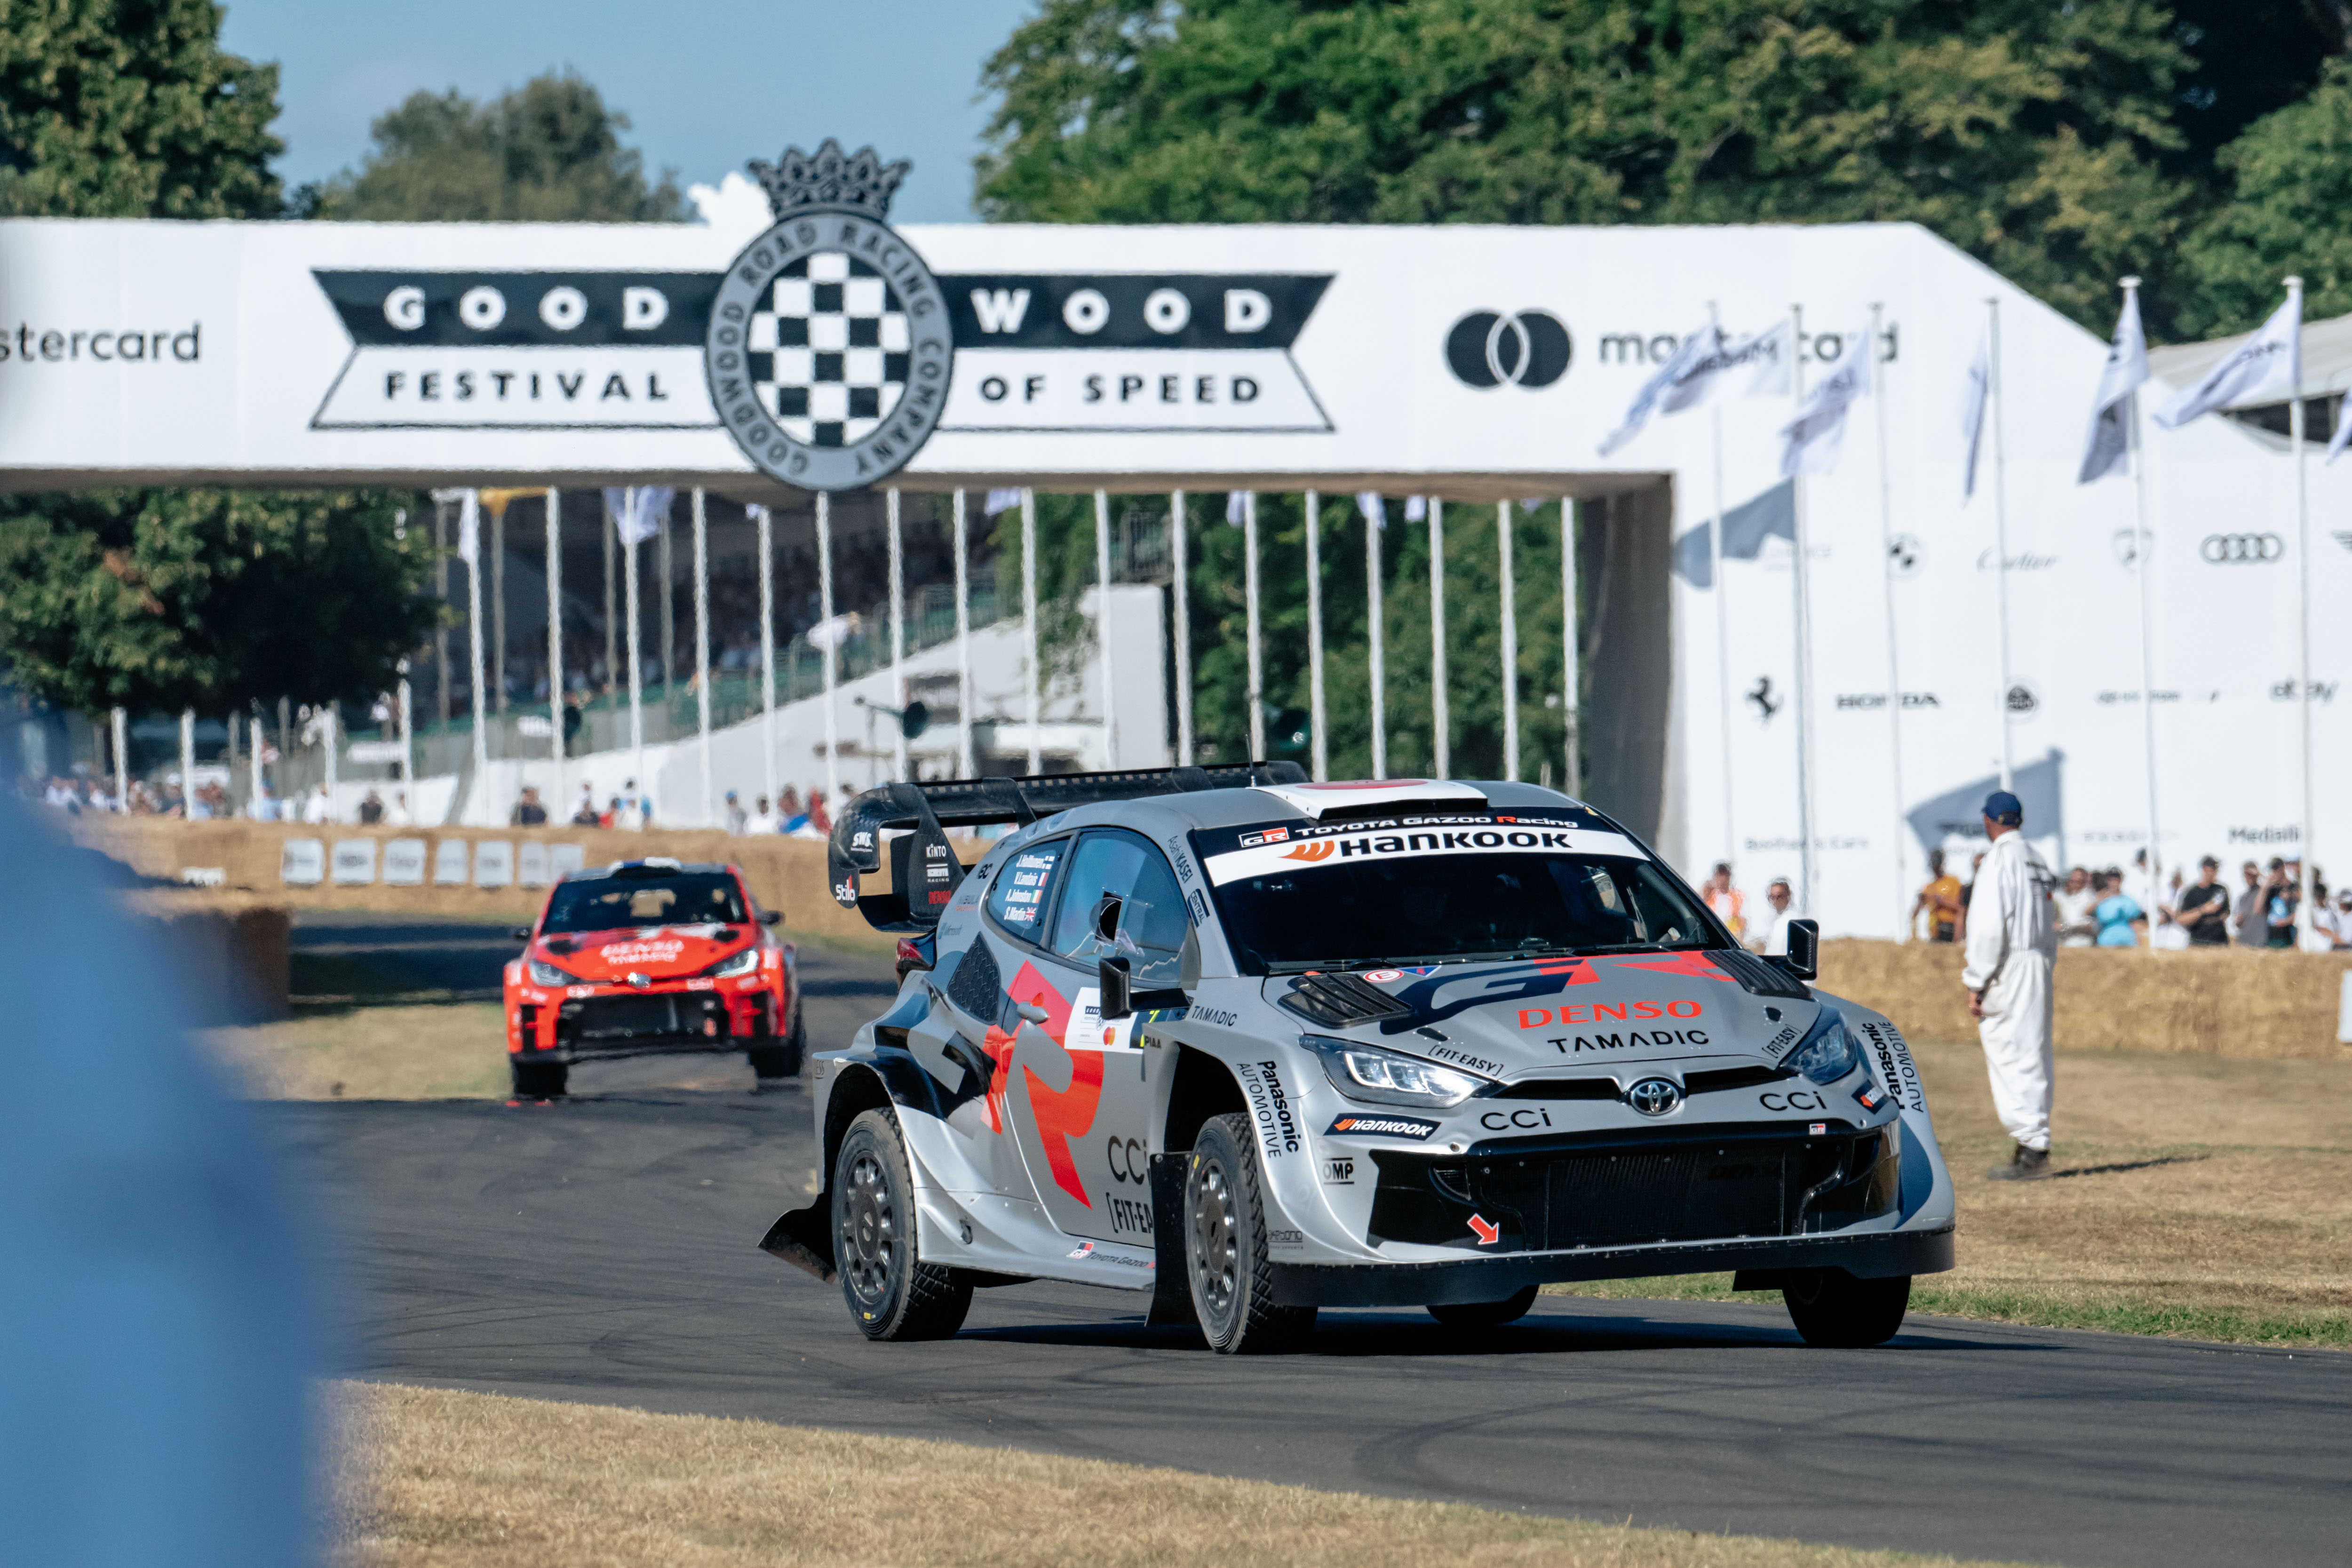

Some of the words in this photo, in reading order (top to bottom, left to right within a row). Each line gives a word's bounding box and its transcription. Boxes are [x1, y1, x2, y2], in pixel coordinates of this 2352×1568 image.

[840, 223, 937, 318] RACING
[383, 285, 670, 331] GOOD
[970, 287, 1273, 334] WOOD
[386, 371, 668, 400] FESTIVAL
[980, 375, 1046, 403] OF
[1083, 375, 1261, 404] SPEED
[715, 301, 807, 474] GOODWOOD
[855, 337, 943, 475] COMPANY
[1243, 832, 1288, 846] GR
[1295, 819, 1398, 836] TOYOTA
[1402, 816, 1492, 826] GAZOO
[835, 876, 855, 901] Stilo
[928, 890, 951, 904] DENSO
[1190, 891, 1204, 924] CENTRAL
[1192, 1005, 1238, 1027] TAMADIC
[1517, 1000, 1702, 1030] DENSO
[1144, 1035, 1162, 1049] PIAA
[1547, 1030, 1709, 1054] TAMADIC
[1861, 1022, 1906, 1111] Panasonic
[1877, 1021, 1924, 1113] AUTOMOTIVE
[1236, 1063, 1282, 1159] AUTOMOTIVE
[1257, 1060, 1302, 1153] Panasonic
